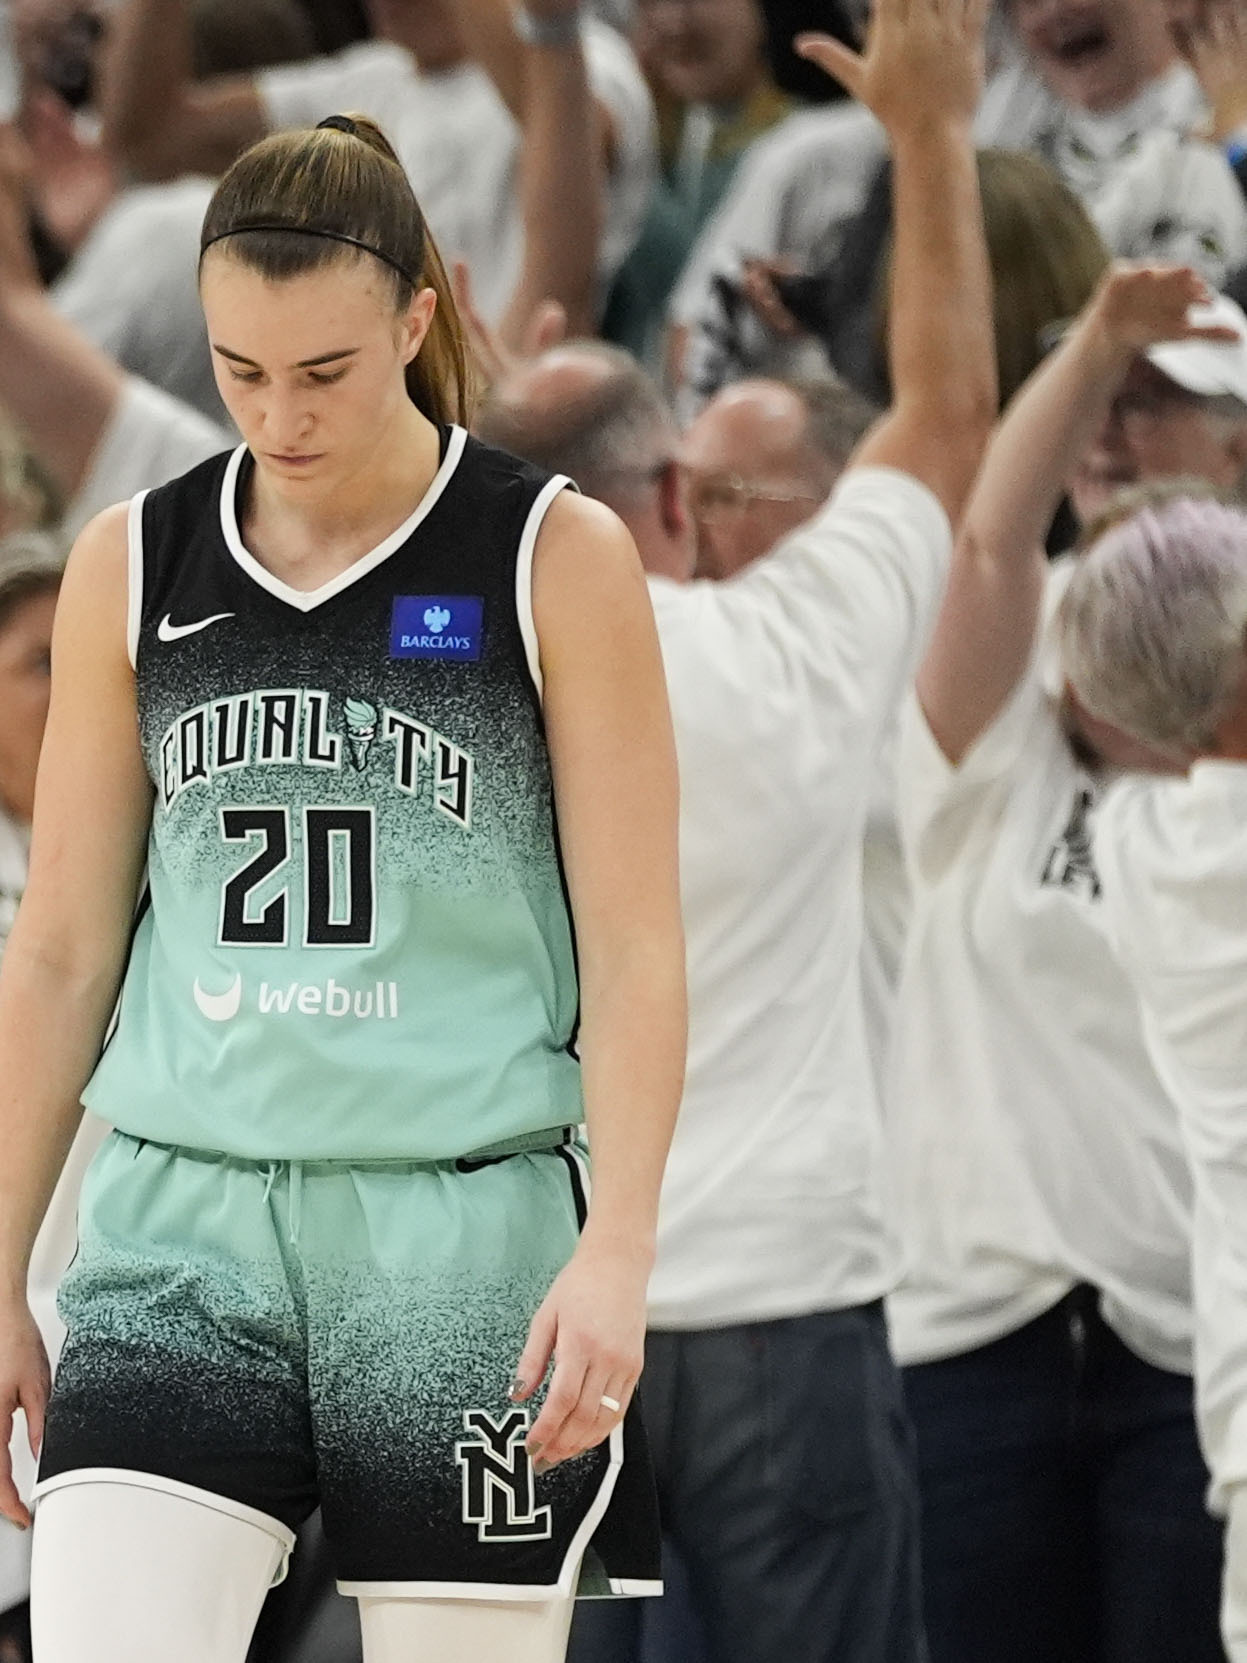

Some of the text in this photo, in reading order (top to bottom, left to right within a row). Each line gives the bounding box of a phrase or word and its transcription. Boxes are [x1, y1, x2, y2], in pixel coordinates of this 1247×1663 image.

[400, 635, 471, 650] BARCLAYS
[218, 806, 376, 949] 20
[258, 979, 398, 1019] webull
